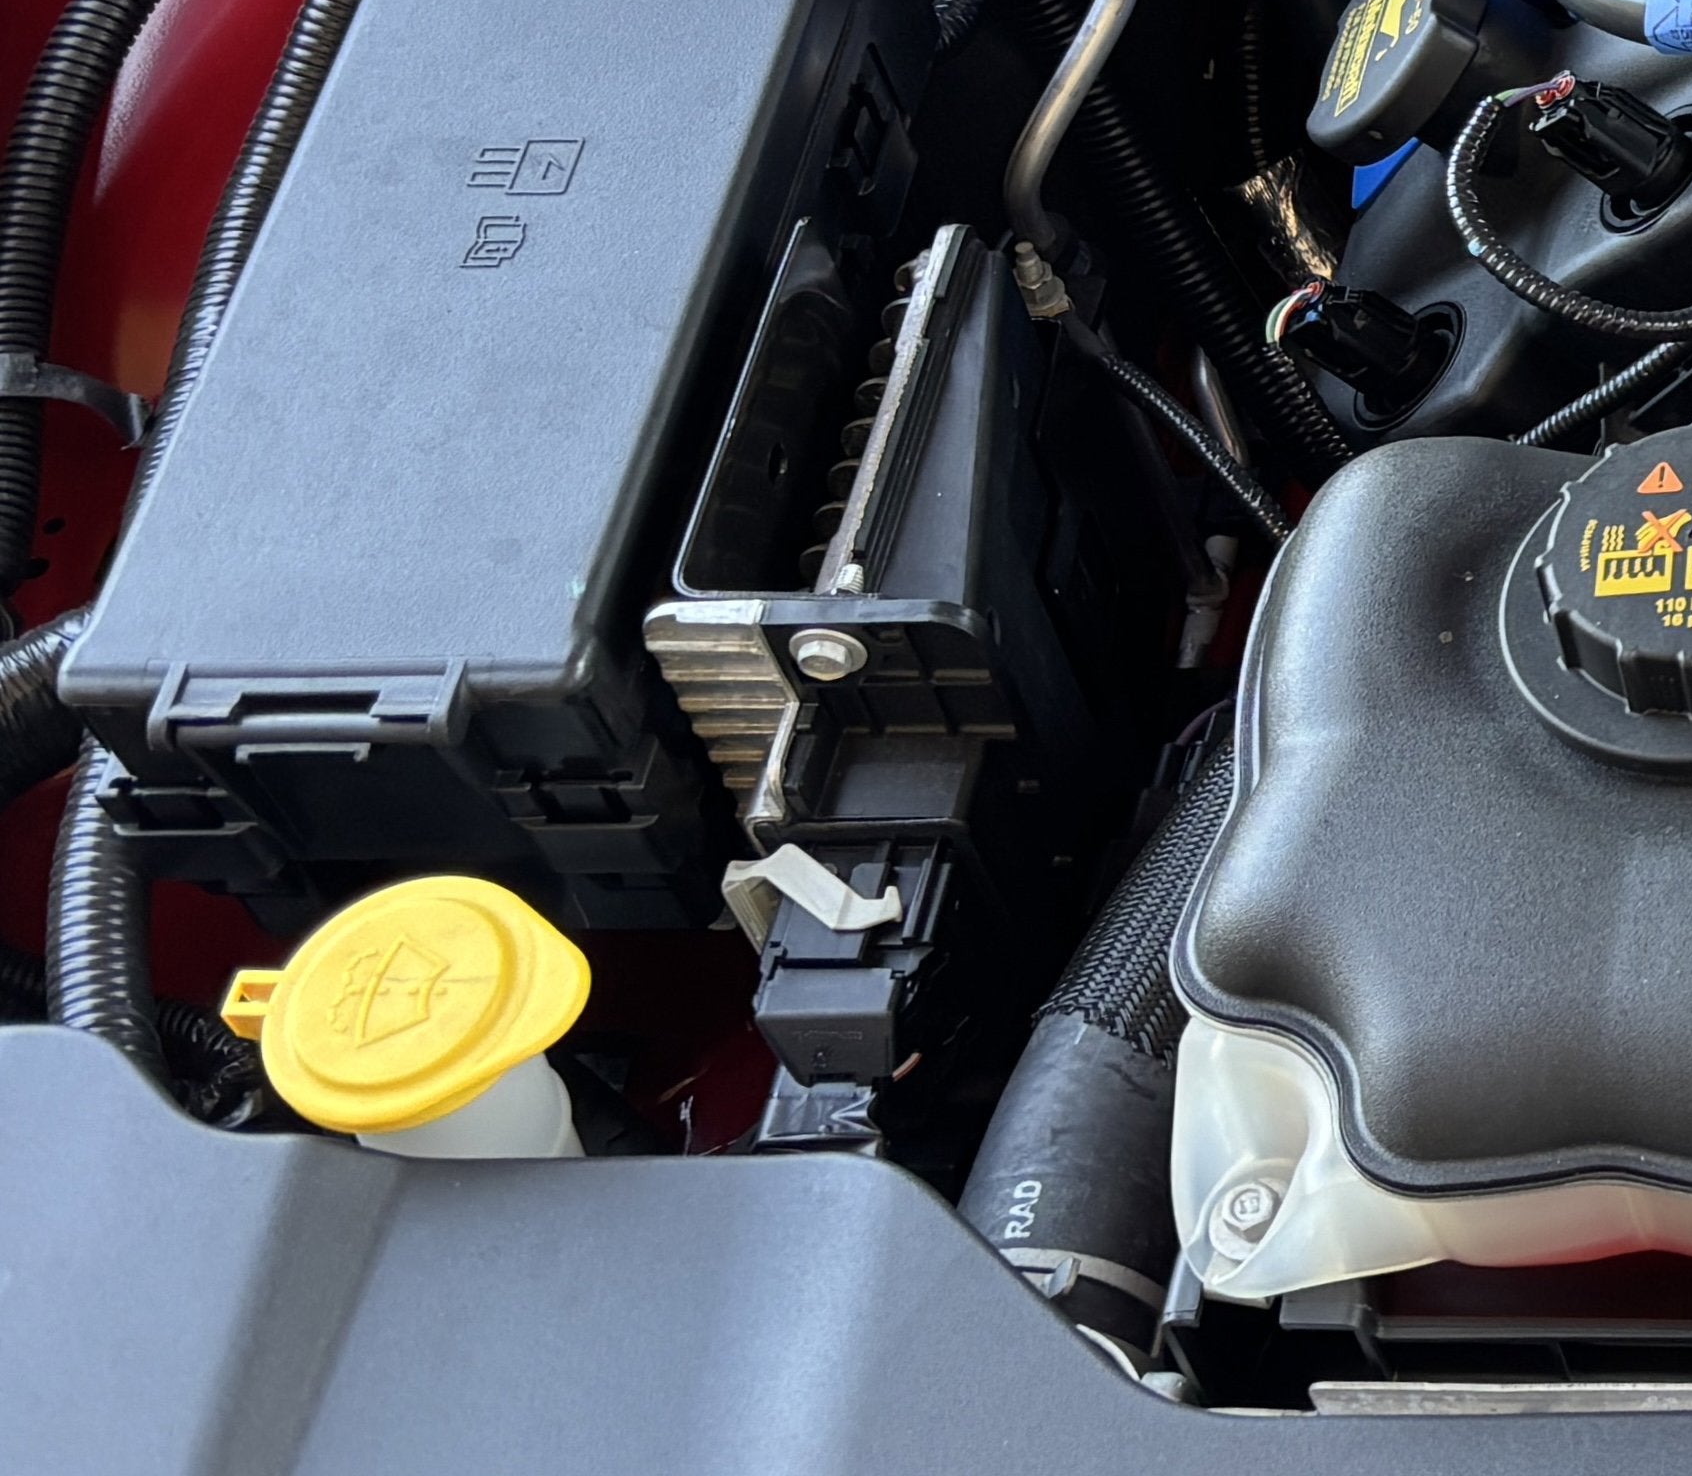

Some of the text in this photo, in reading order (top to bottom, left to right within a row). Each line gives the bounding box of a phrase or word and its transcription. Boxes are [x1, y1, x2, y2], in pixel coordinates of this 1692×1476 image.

[1655, 598, 1687, 613] 110
[1662, 613, 1684, 627] 16
[1004, 1180, 1043, 1241] RAD
